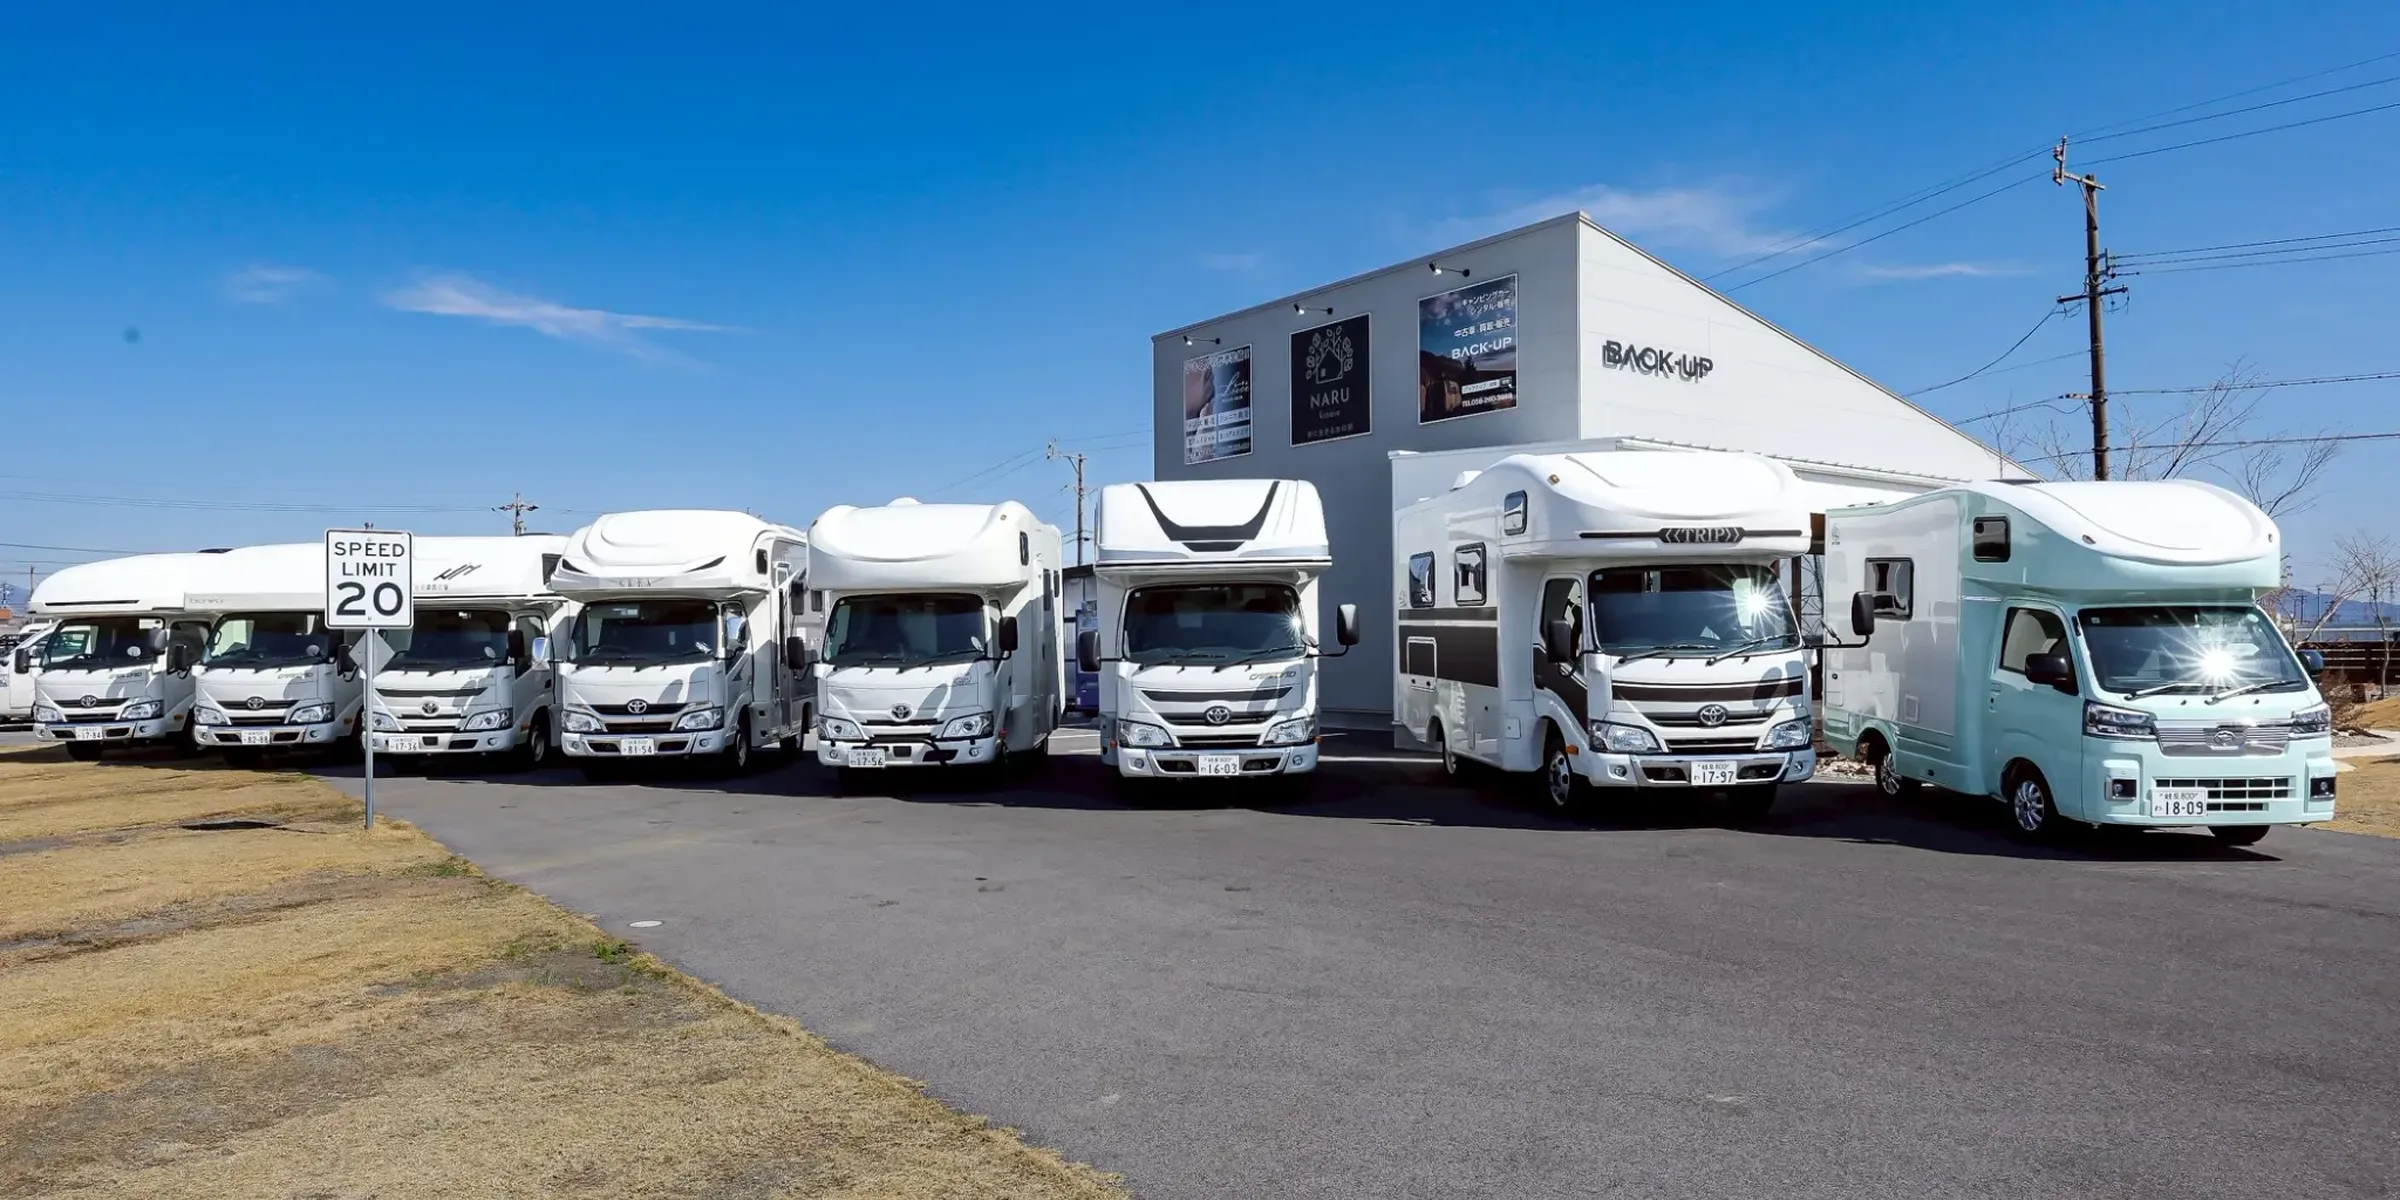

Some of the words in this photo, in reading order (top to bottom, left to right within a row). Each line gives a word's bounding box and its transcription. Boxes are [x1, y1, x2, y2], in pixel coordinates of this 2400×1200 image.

[1451, 336, 1512, 360] BACK-UP
[1605, 339, 1714, 379] BACK-UP
[1310, 386, 1350, 409] NARU
[1681, 527, 1726, 543] TRIP
[334, 541, 405, 557] SPEED
[342, 562, 397, 577] LIMIT
[336, 581, 404, 617] 20
[627, 745, 652, 754] 81-54
[857, 757, 883, 766] 17-56
[1208, 763, 1237, 775] 16-03
[1702, 770, 1735, 783] 17-97
[2164, 801, 2202, 815] 18-09
